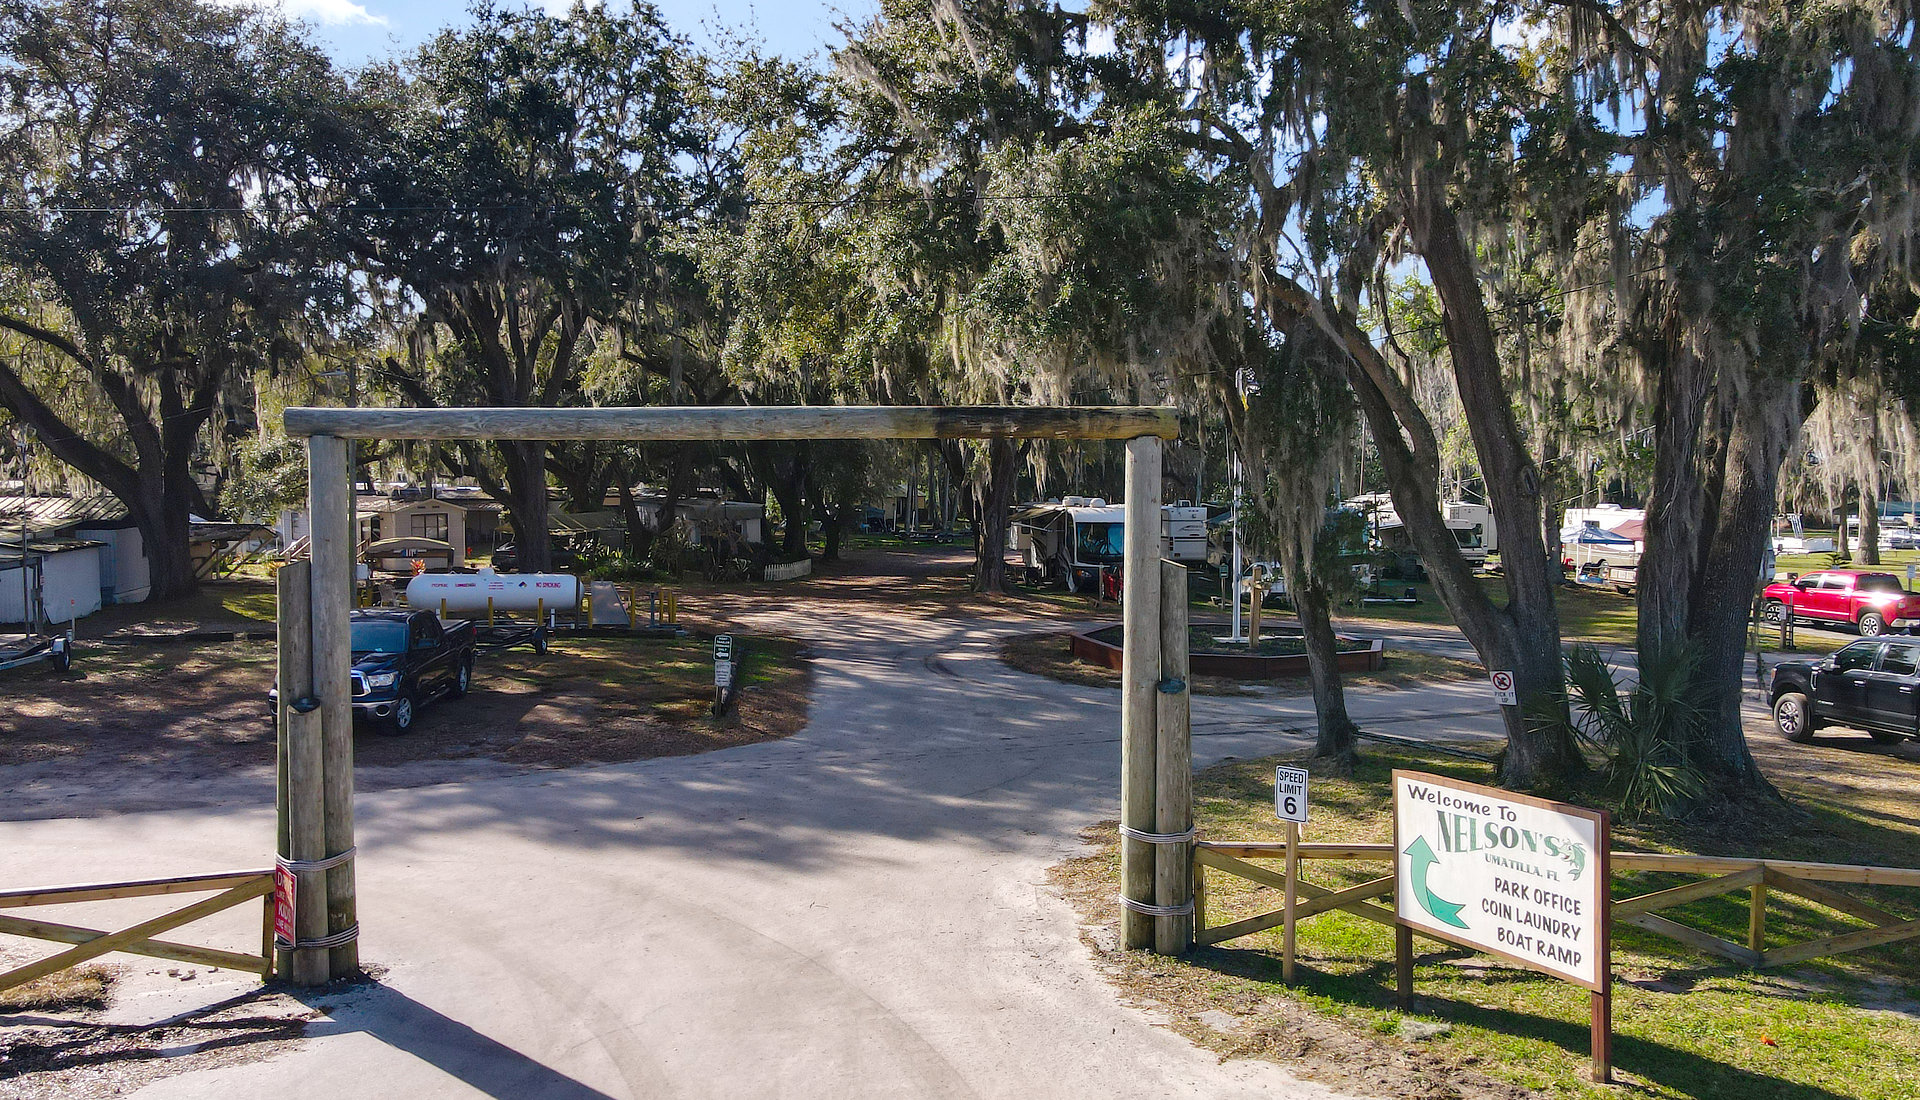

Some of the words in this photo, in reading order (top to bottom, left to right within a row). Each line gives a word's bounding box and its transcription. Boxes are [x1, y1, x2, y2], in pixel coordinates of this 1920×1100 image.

[1279, 771, 1303, 783] SPEED
[1279, 783, 1302, 795] LIMIT
[1284, 796, 1297, 815] 6
[1407, 784, 1491, 816] Welcome
[1497, 805, 1517, 822] To
[1436, 810, 1561, 857] NELSON'S
[1546, 869, 1560, 882] FL
[1494, 877, 1530, 901] PARK
[1533, 888, 1582, 916] OFFICE
[1481, 897, 1512, 921] COIN
[1516, 907, 1582, 941] LAUNDRY
[1497, 927, 1533, 951] BOAT
[1536, 939, 1582, 967] RAMP
